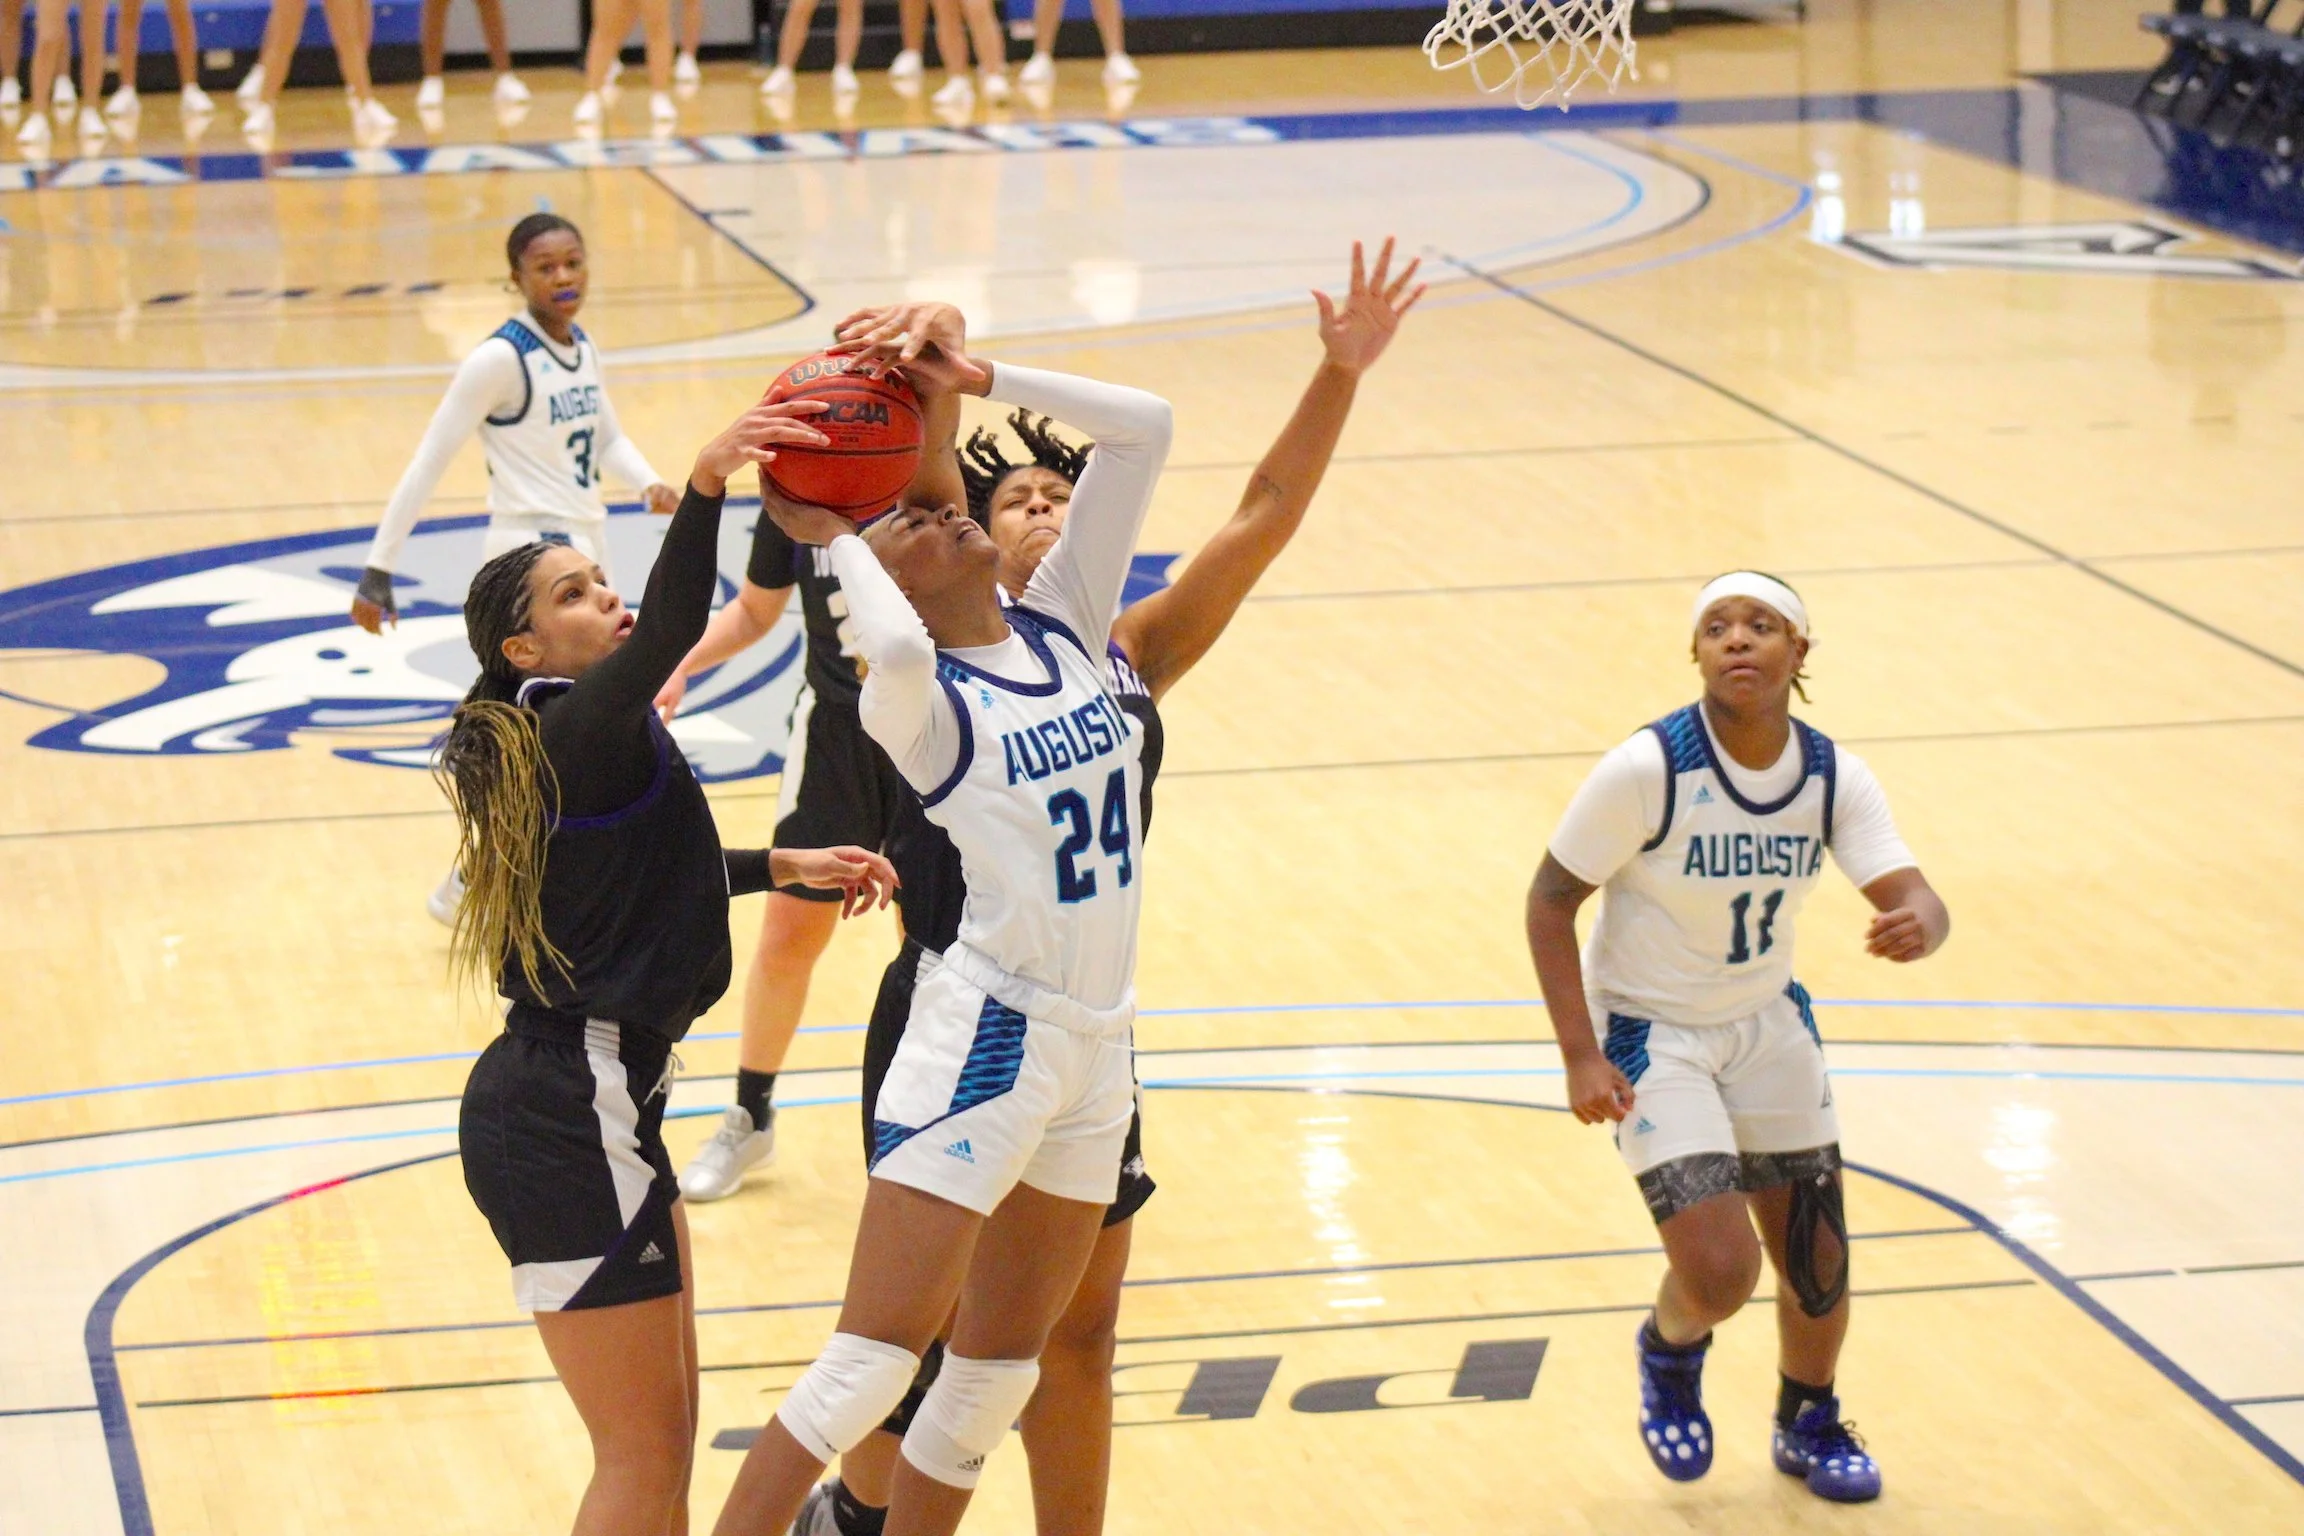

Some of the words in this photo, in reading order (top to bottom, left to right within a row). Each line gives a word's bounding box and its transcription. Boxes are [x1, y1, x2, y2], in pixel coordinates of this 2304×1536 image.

[1047, 767, 1132, 903] 24
[1683, 832, 1822, 878] AUGUSTA
[1726, 888, 1785, 964] 11
